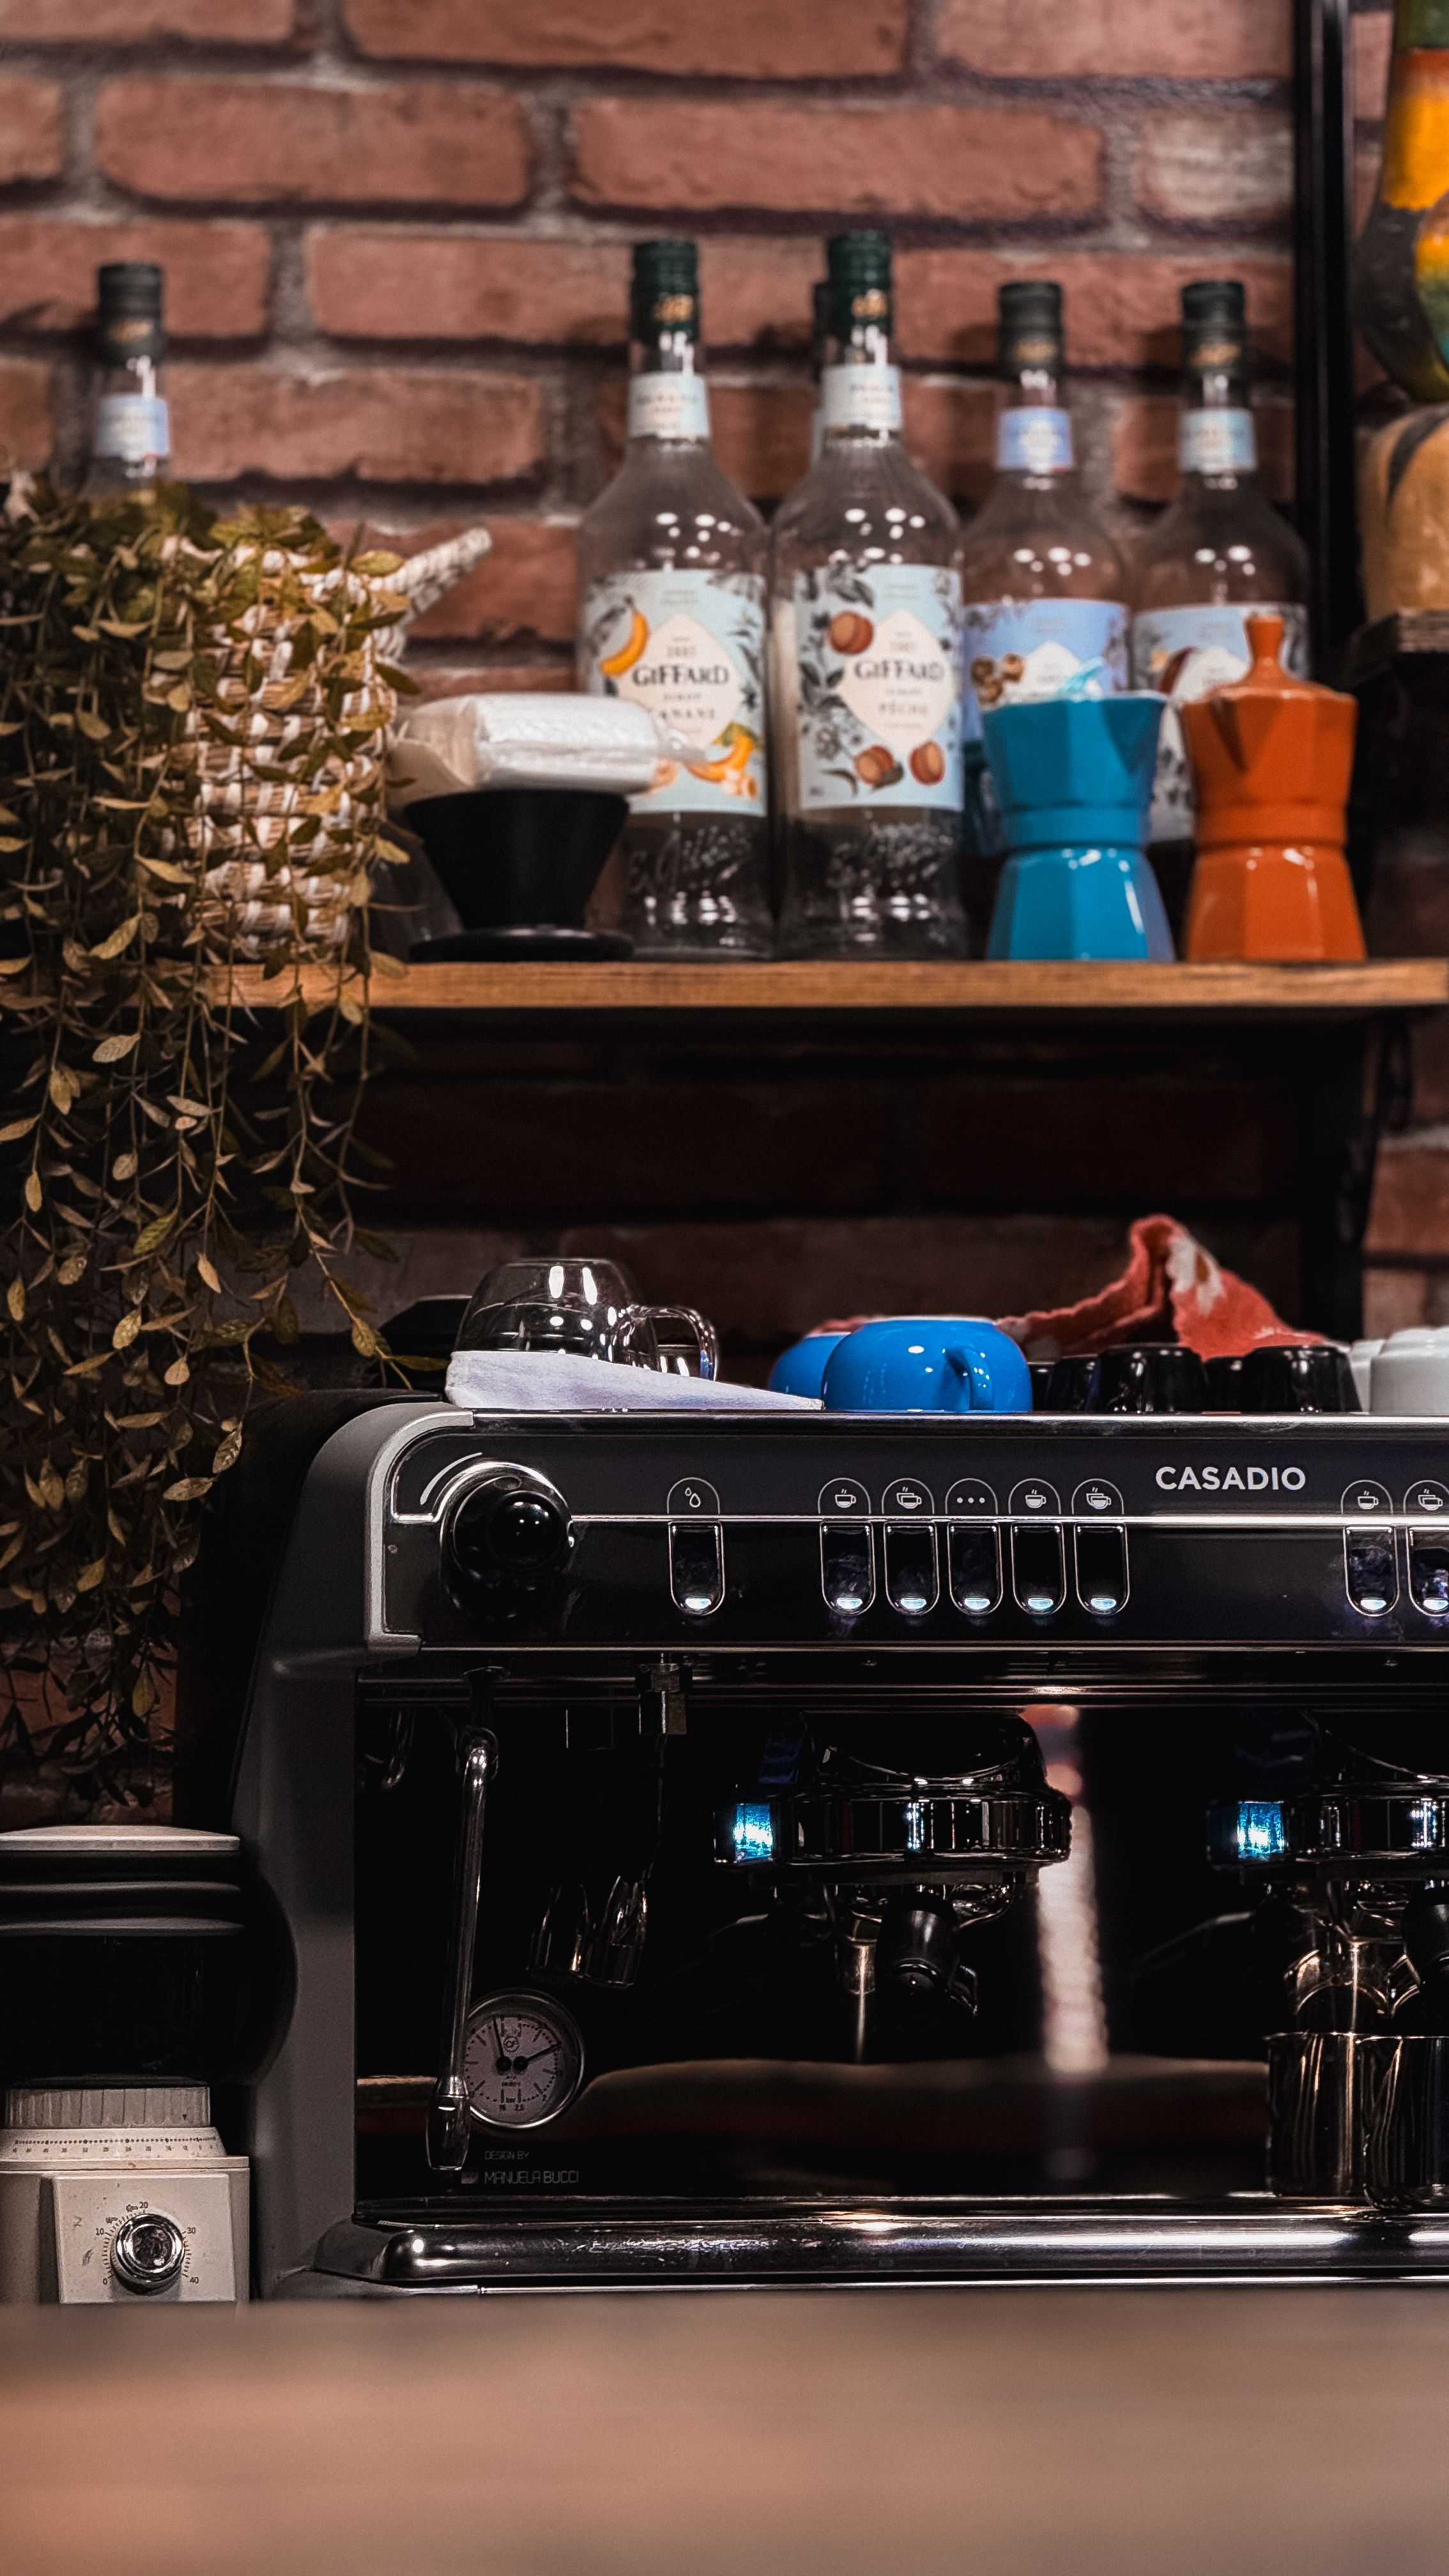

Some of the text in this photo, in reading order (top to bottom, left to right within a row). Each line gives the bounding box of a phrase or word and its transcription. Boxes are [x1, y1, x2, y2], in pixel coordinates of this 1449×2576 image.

[632, 664, 730, 686] GIFFARD
[854, 659, 946, 682] GIFFARD
[1155, 1466, 1306, 1491] CASADIO
[484, 2150, 530, 2160] DESIGN BY
[484, 2171, 579, 2184] MANUELA BUCCI
[187, 2227, 196, 2235] 30
[102, 2277, 108, 2285] 0
